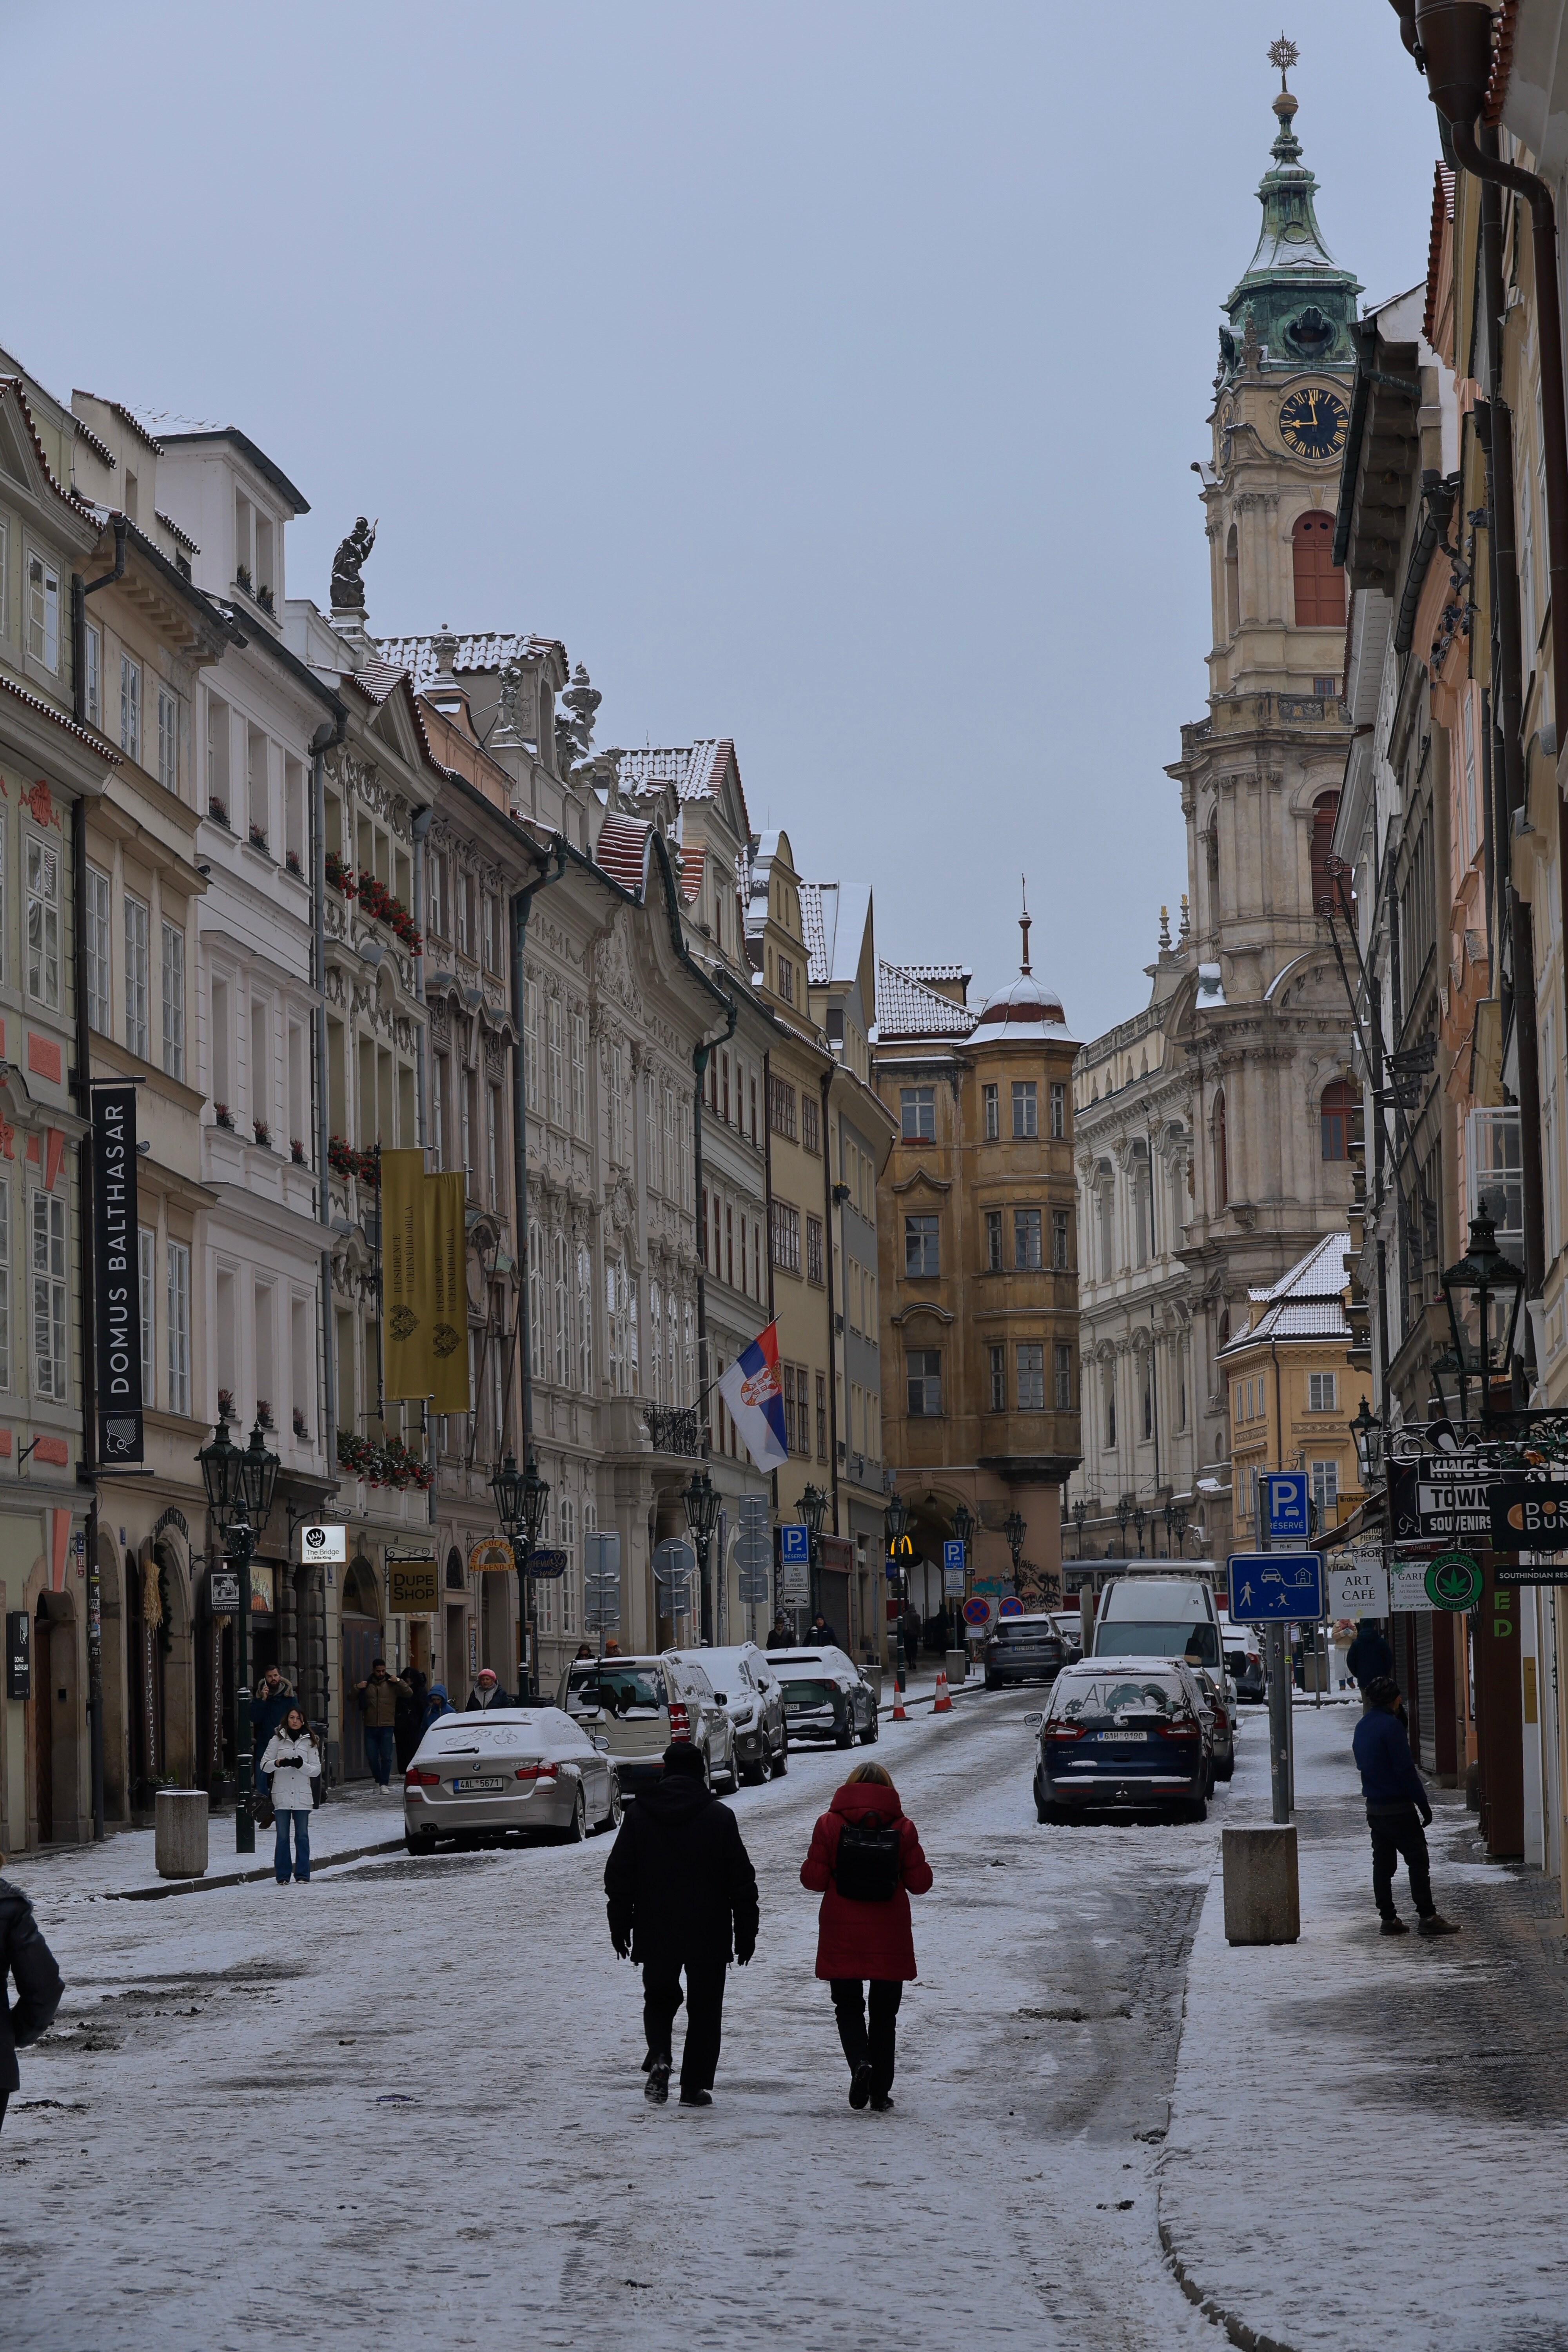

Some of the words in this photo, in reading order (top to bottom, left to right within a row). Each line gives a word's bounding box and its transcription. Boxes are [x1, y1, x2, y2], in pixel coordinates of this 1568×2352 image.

[1283, 404, 1296, 414] X
[1312, 446, 1320, 458] VI
[1327, 443, 1336, 455] V
[105, 1105, 126, 1270] BALTHASAR
[405, 1206, 413, 1233] ORLA
[446, 1228, 454, 1255] ORLA
[393, 1234, 402, 1292] RESIDENCE
[404, 1236, 414, 1283] ČERNÉHO
[435, 1255, 444, 1312] RESIDENCE
[446, 1256, 456, 1302] ČERNÉHO
[109, 1288, 129, 1393] DOMUS
[1430, 1459, 1489, 1478] KING'S
[1272, 1481, 1298, 1517] P
[1430, 1487, 1490, 1509] TOWN
[1270, 1520, 1304, 1529] RÉSERVÉ
[1430, 1515, 1492, 1531] SOUVENIRS
[788, 1531, 802, 1552] P
[471, 1549, 481, 1563] PUB
[484, 1540, 515, 1563] COCKTAIL
[948, 1545, 960, 1561] P
[528, 1560, 549, 1568] BOHEMIA
[1431, 1556, 1454, 1573] WEED
[1456, 1556, 1477, 1572] SHOP
[394, 1573, 433, 1586] DUPE
[1344, 1575, 1371, 1586] ART
[394, 1587, 434, 1600] SHOP
[1342, 1587, 1376, 1601] CAFÉ
[1436, 1593, 1474, 1610] COMPANY
[146, 1630, 155, 1766] MANUFAKTURA
[460, 1780, 474, 1788] 4AL
[480, 1779, 499, 1787] 5671
